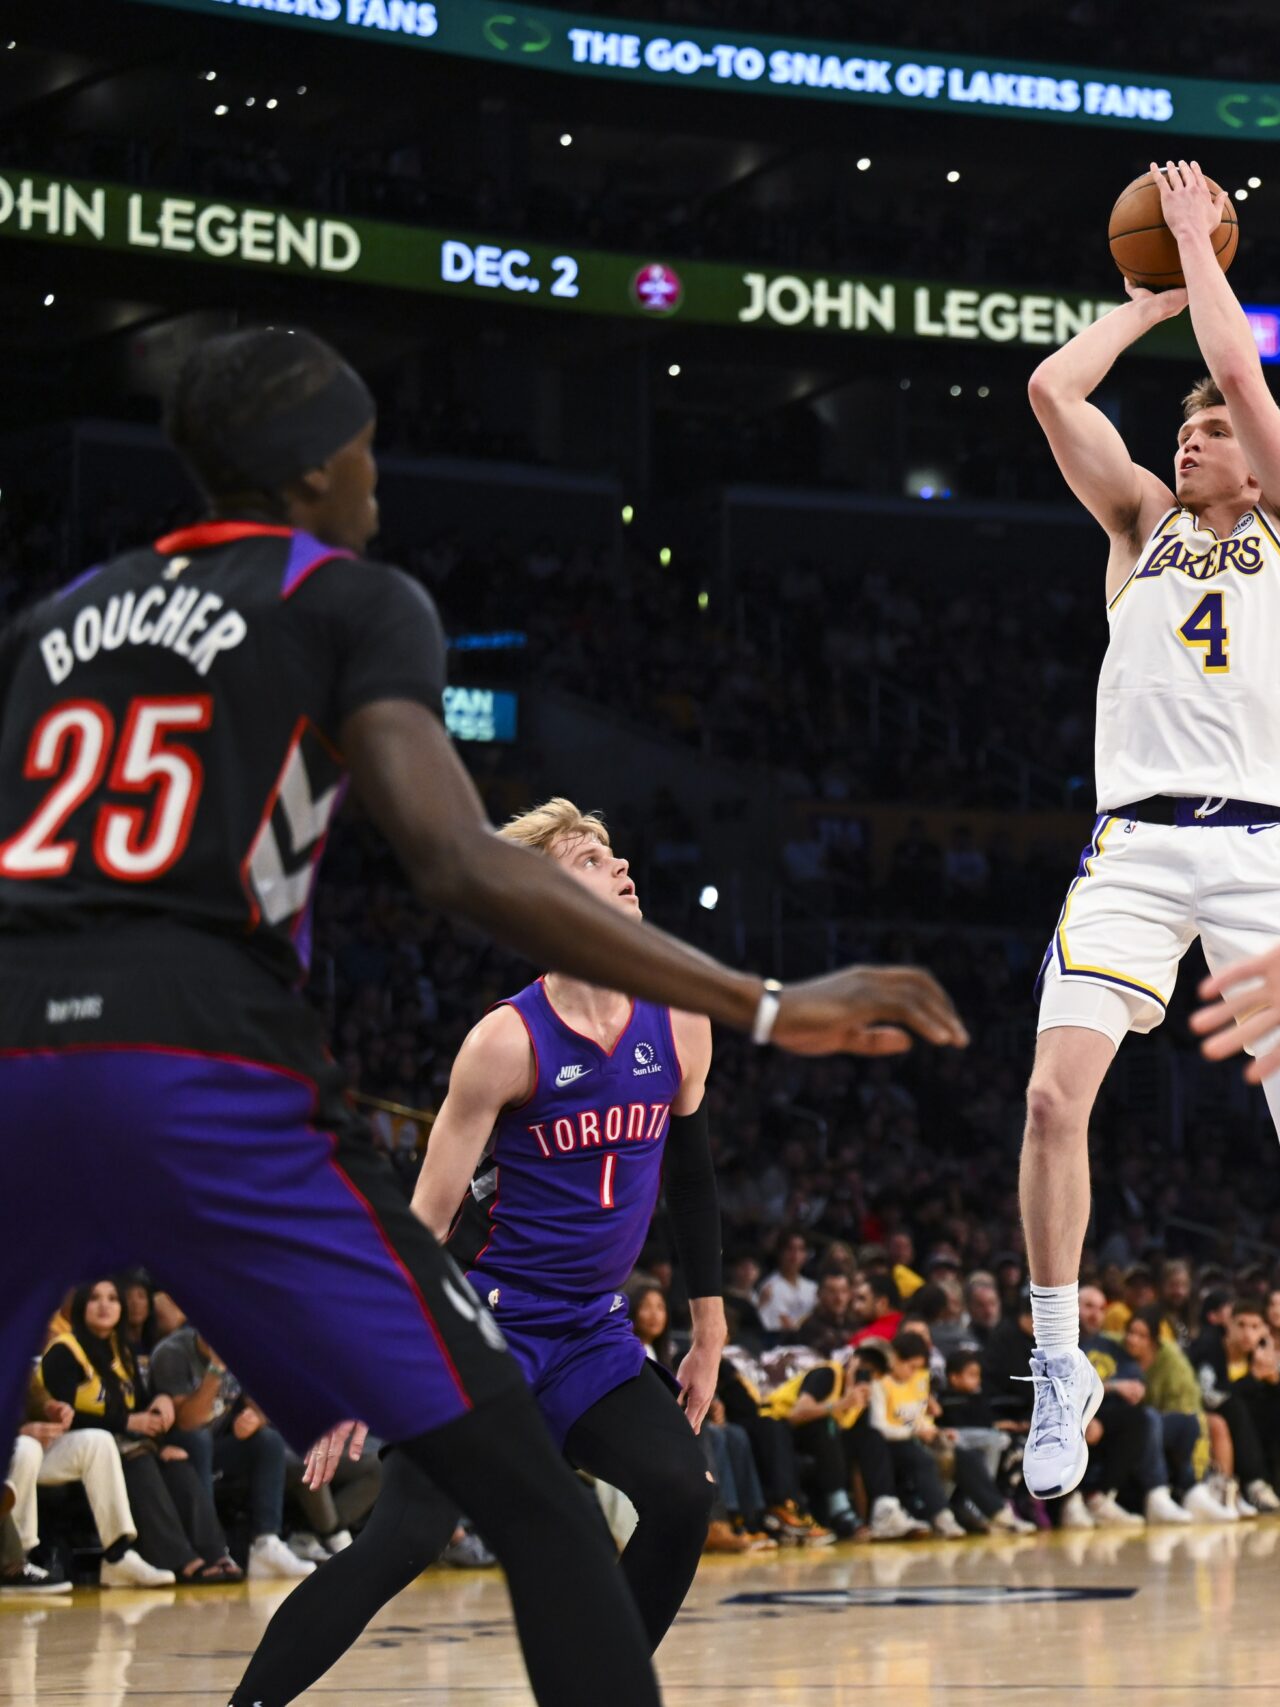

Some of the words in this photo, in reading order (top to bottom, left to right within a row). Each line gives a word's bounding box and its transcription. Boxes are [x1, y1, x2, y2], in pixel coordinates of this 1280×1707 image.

[346, 0, 438, 37] FANS
[568, 28, 640, 69] THE
[644, 38, 766, 81] GO-TO
[769, 50, 893, 94] SNACK
[895, 63, 945, 98] OF
[948, 67, 1080, 112] LAKERS
[1083, 81, 1174, 121] FANS
[127, 192, 361, 273] LEGEND
[441, 239, 540, 293] DEC.
[549, 255, 579, 298] 2
[738, 272, 896, 333] JOHN
[914, 286, 1120, 345] LEGEN
[1135, 534, 1264, 579] LAKERS
[40, 585, 247, 685] BOUCHER
[1176, 590, 1231, 674] 4
[0, 693, 214, 882] 25
[560, 1064, 583, 1079] NIKE
[632, 1067, 647, 1076] Sun
[647, 1063, 662, 1074] Life
[600, 1152, 618, 1208] 1
